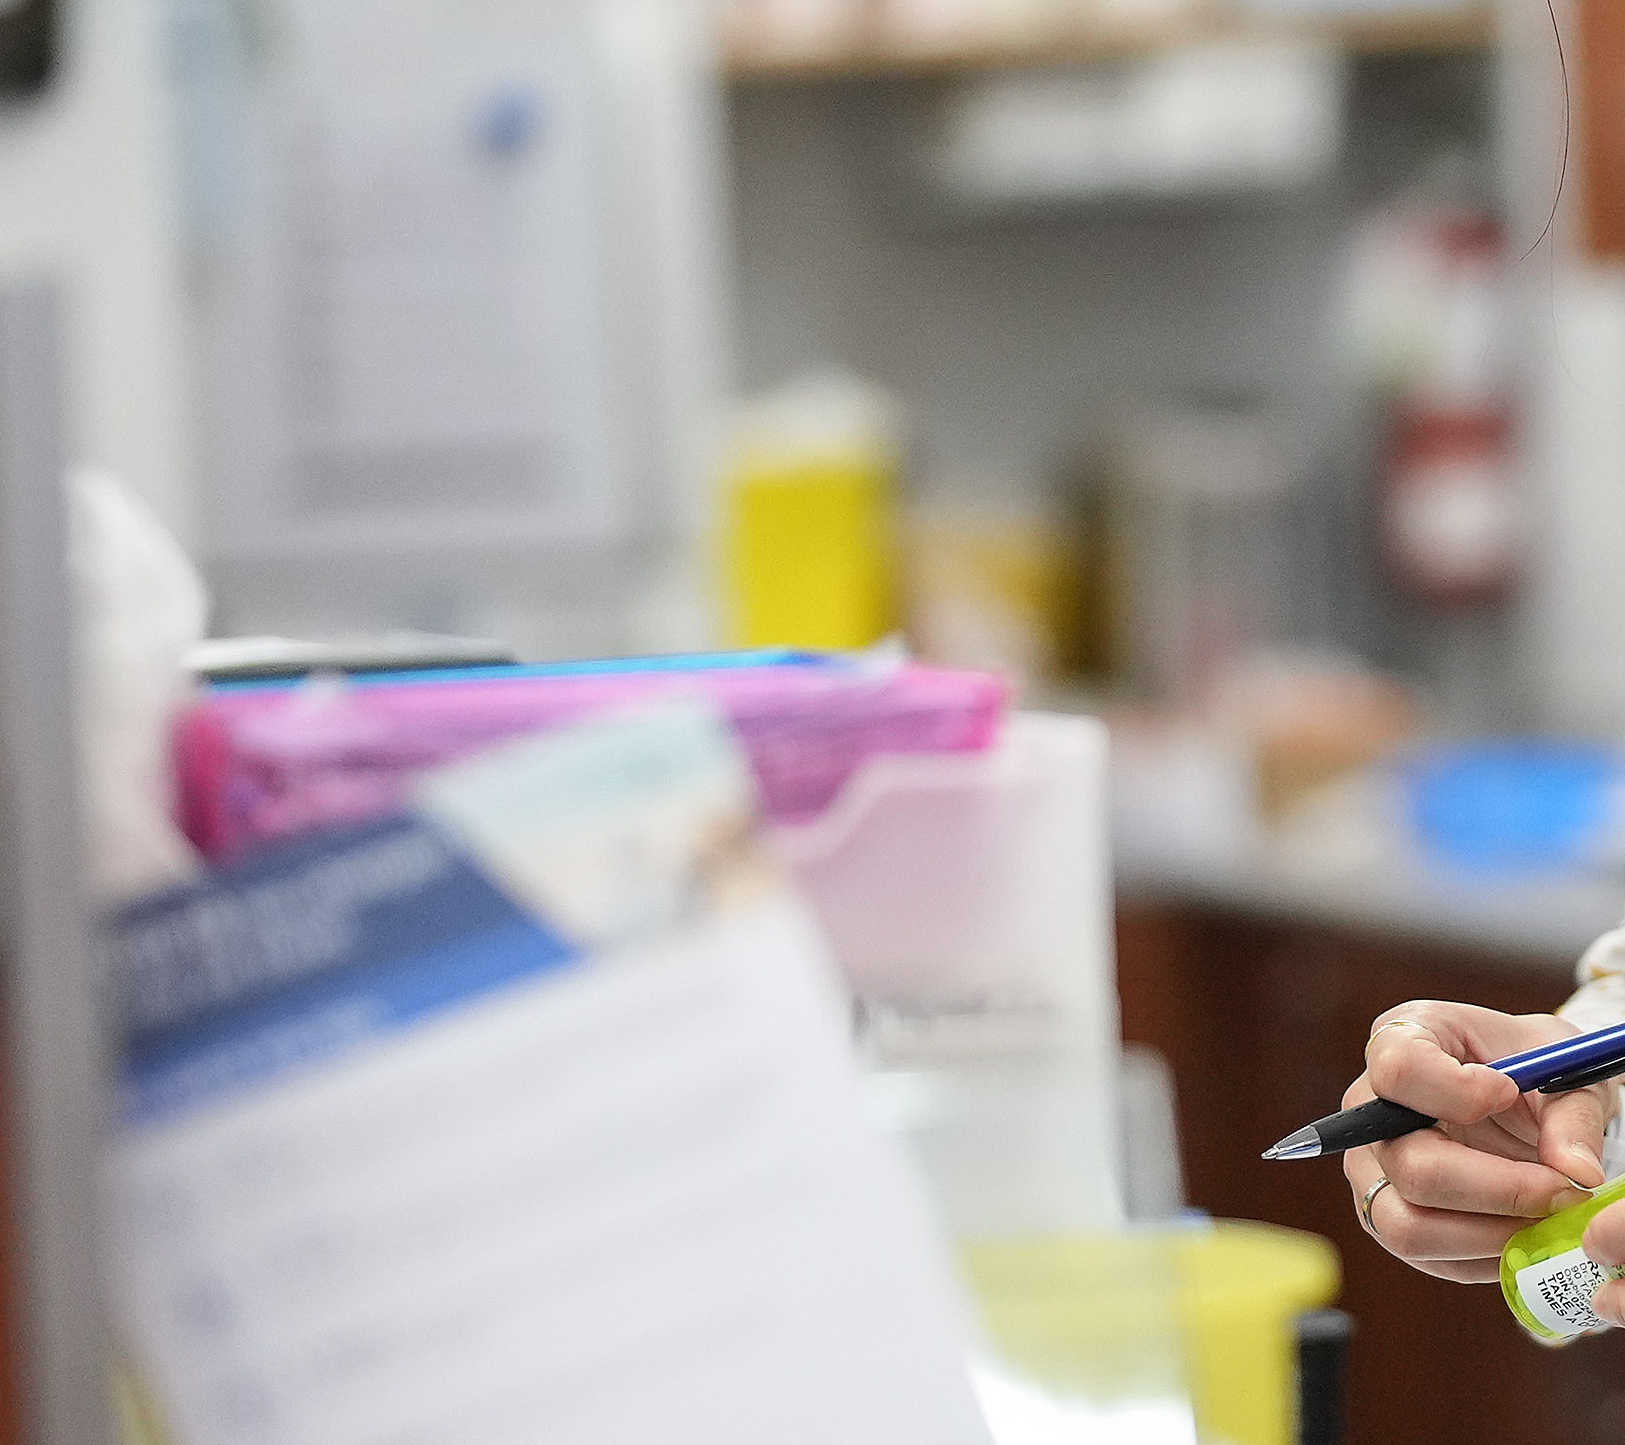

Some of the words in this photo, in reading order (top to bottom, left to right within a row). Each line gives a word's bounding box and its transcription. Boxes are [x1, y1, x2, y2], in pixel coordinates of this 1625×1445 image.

[1555, 1271, 1572, 1296] DIN:
[1571, 1265, 1582, 1280] 90
[1537, 1277, 1568, 1318] TIMES
[1565, 1316, 1578, 1325] A
[1547, 1274, 1575, 1310] TAKE
